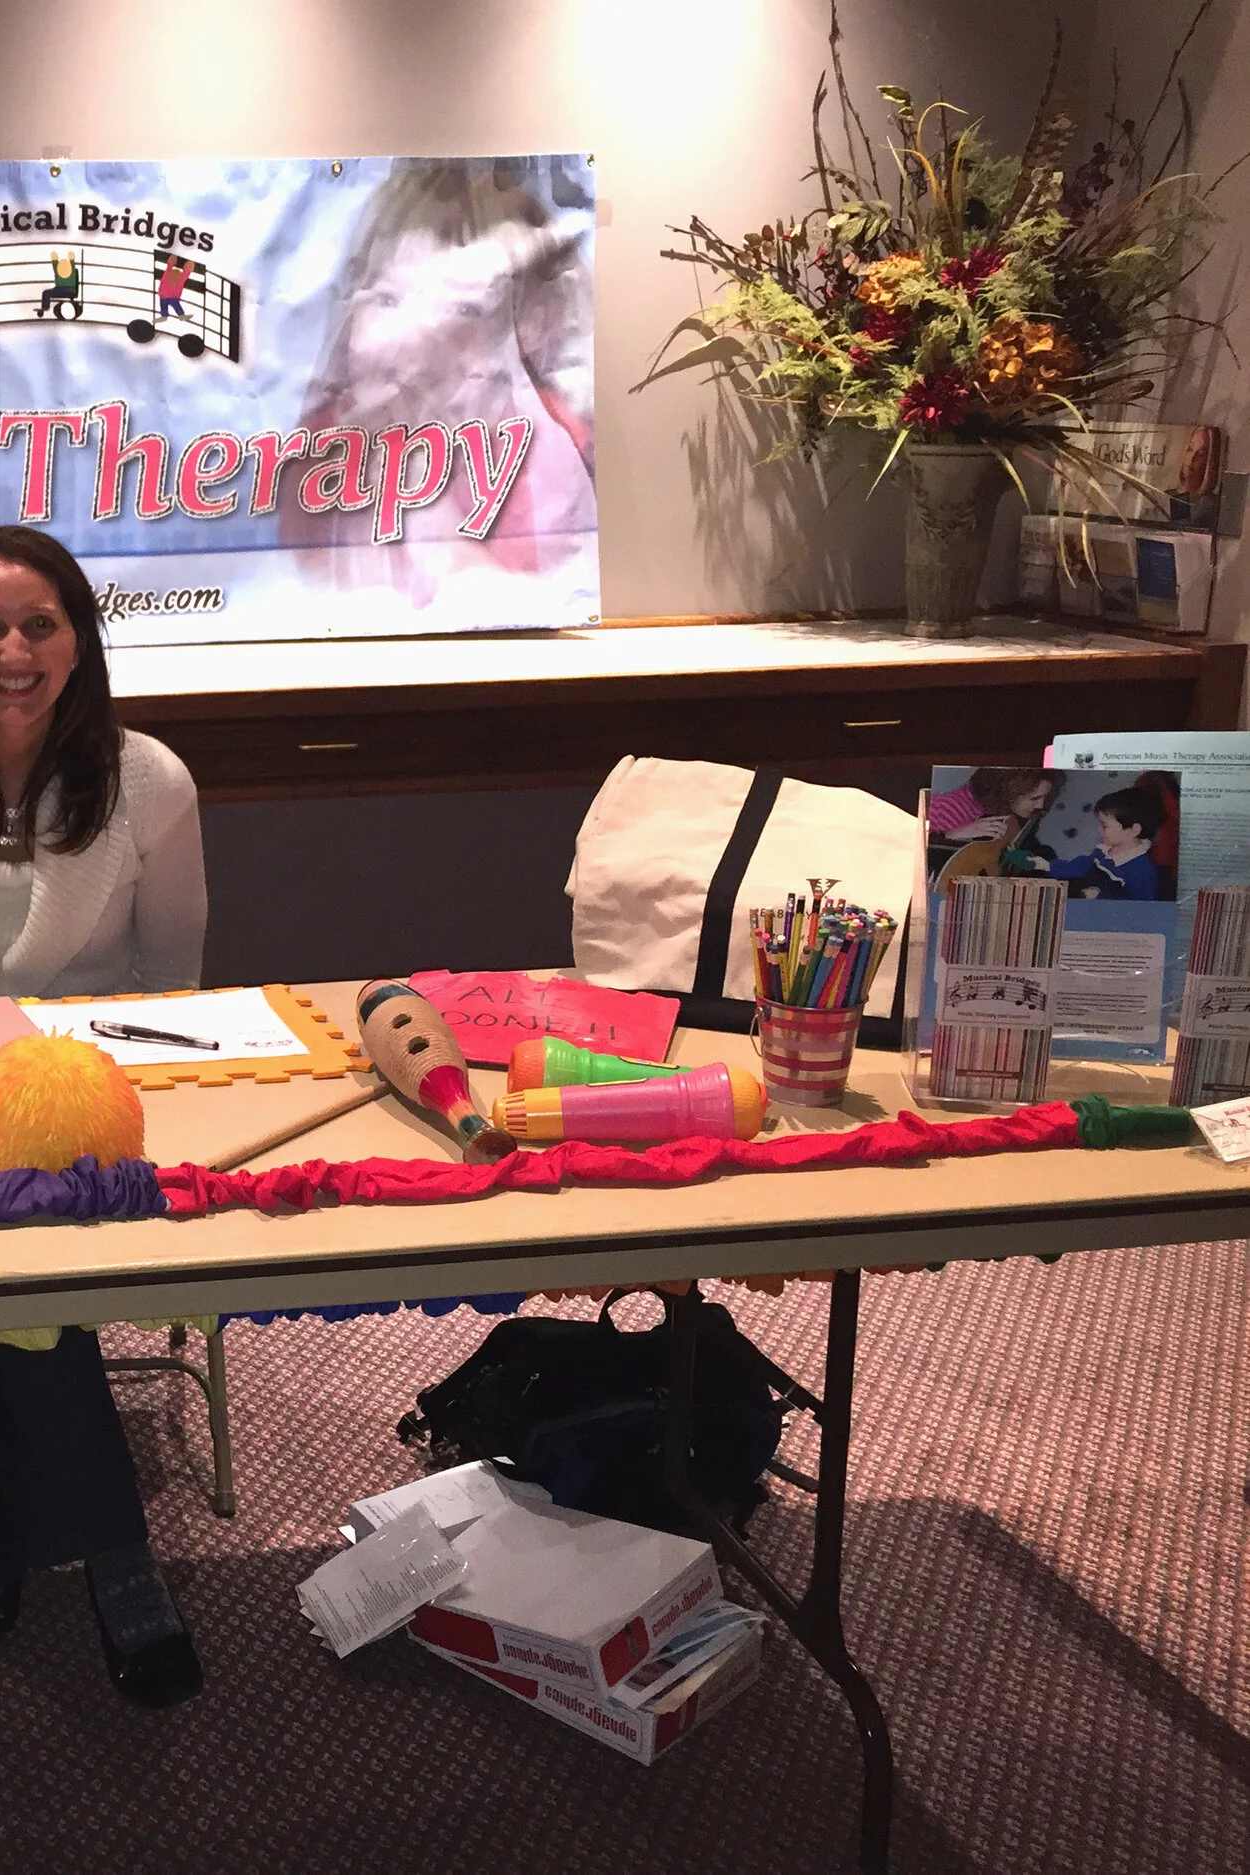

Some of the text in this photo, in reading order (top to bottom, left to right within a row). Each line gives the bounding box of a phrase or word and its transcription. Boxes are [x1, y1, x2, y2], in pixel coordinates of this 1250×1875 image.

[78, 204, 215, 252] Bridges
[1098, 442, 1167, 466] God's Word
[1101, 752, 1142, 760] American
[1144, 752, 1169, 760] Music
[1173, 751, 1206, 762] Therapy
[962, 973, 1002, 982] Musical
[544, 1684, 638, 1743] alphagraphics
